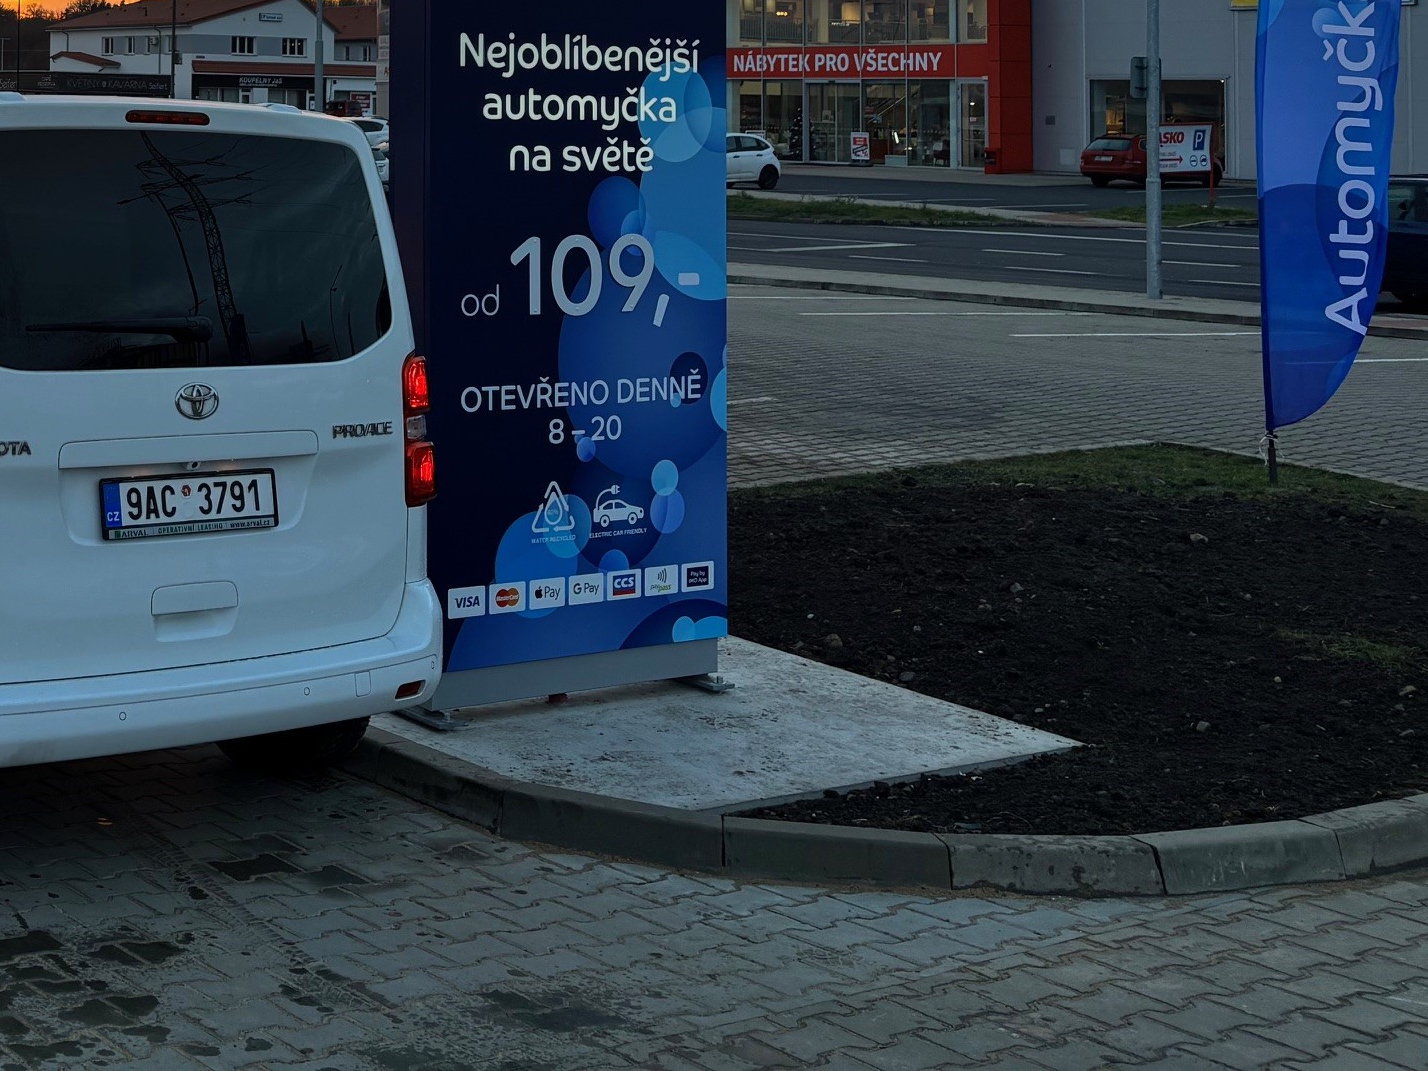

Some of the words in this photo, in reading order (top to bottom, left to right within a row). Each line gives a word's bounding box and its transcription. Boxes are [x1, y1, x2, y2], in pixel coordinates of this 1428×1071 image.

[459, 32, 700, 83] Nejoblíbenější
[733, 50, 810, 72] NÁBYTEK
[814, 52, 850, 72] PRO
[853, 48, 943, 72] VŠECHNY
[0, 78, 18, 89] Seifer
[482, 86, 677, 131] automyčka
[509, 143, 551, 172] na
[561, 137, 654, 172] světě
[461, 284, 500, 317] od
[460, 377, 610, 413] OTEVŘENO
[617, 368, 702, 405] DENNĚ
[548, 418, 565, 445] 8
[590, 415, 622, 442] 20
[126, 485, 177, 521] 9AC
[197, 479, 261, 515] 3791
[107, 511, 120, 522] CZ
[121, 529, 149, 538] ARVAL
[229, 519, 271, 529] www.arval.cz
[589, 531, 613, 539] ELECTRIC
[624, 527, 648, 535] FRIENDLY
[544, 585, 561, 600] Pay
[573, 582, 582, 595] G
[583, 582, 600, 596] Pay
[613, 576, 635, 589] CCS
[454, 595, 480, 609] VISA
